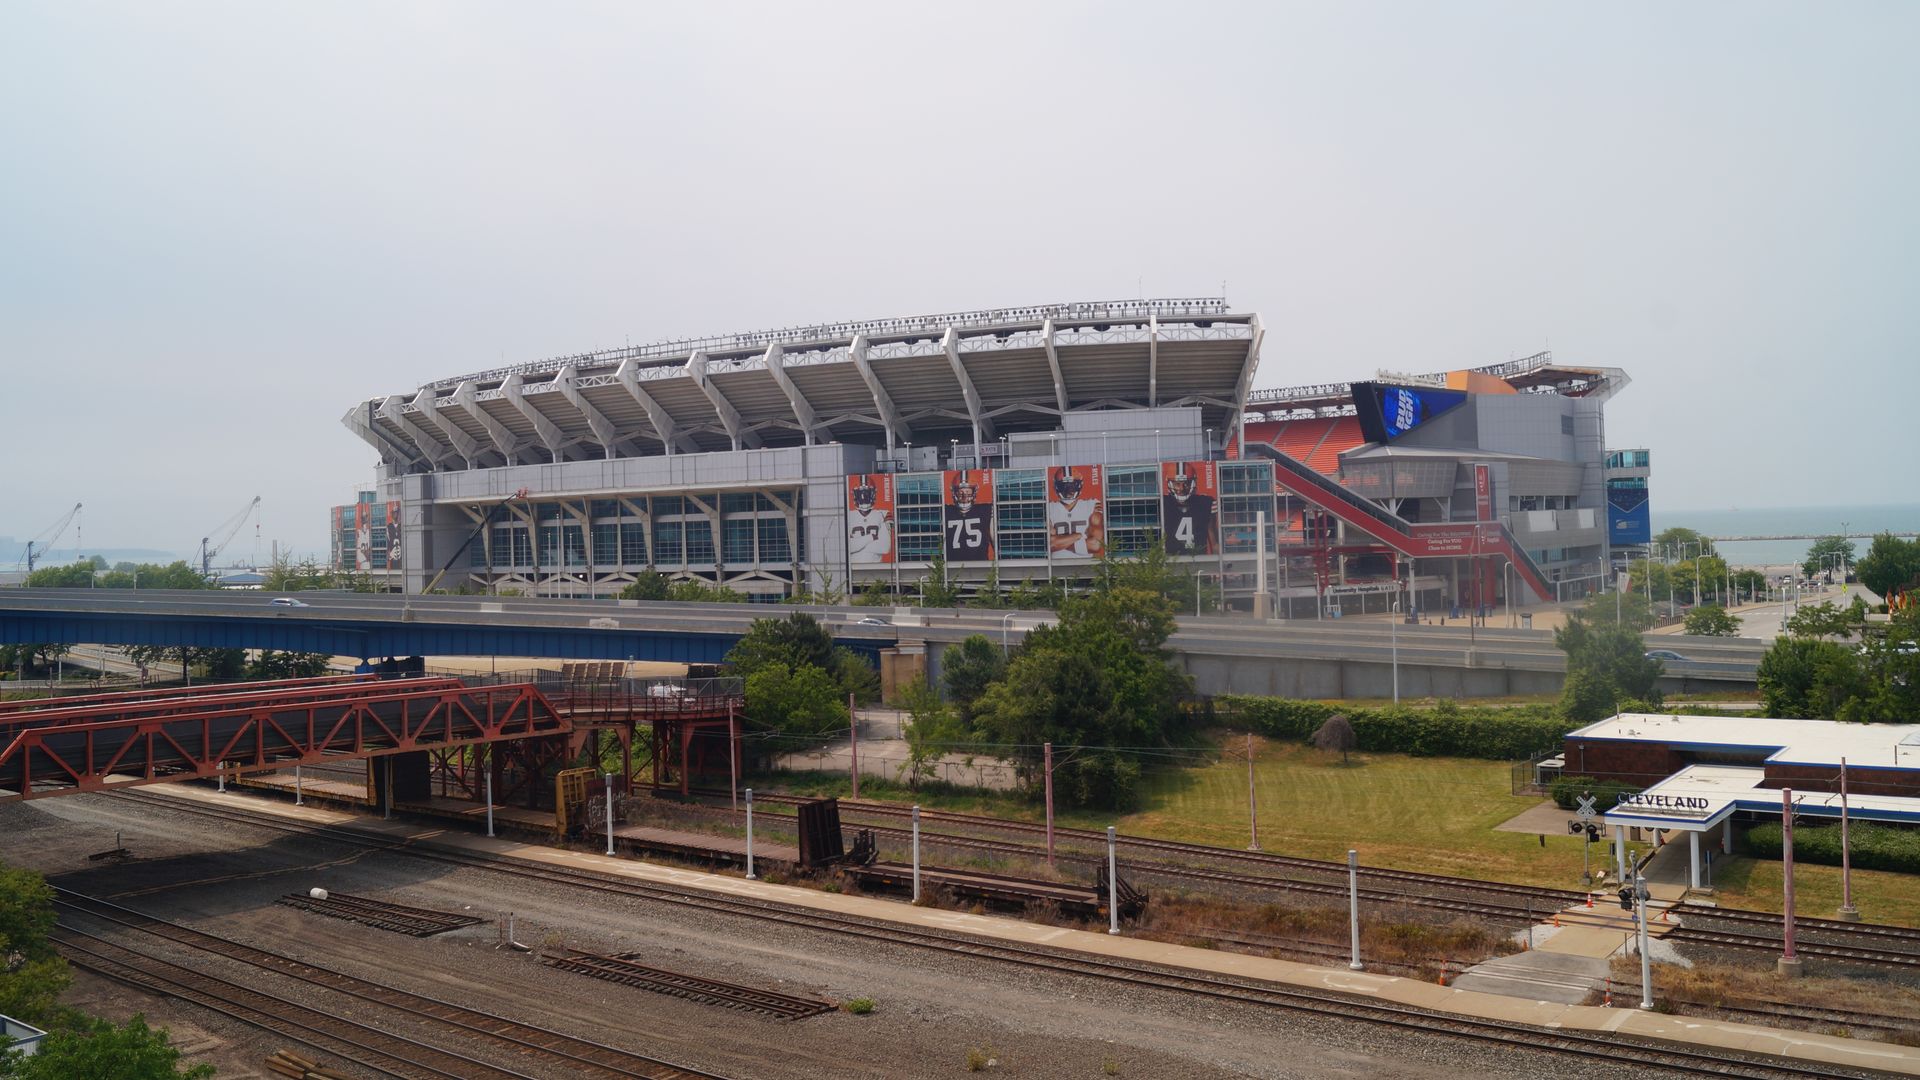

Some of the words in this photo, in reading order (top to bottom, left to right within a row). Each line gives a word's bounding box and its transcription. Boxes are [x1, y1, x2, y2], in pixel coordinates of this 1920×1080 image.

[1395, 389, 1406, 430] BUD
[948, 518, 982, 549] 75
[1174, 516, 1195, 549] 4
[1617, 792, 1709, 809] CLEVELAND
